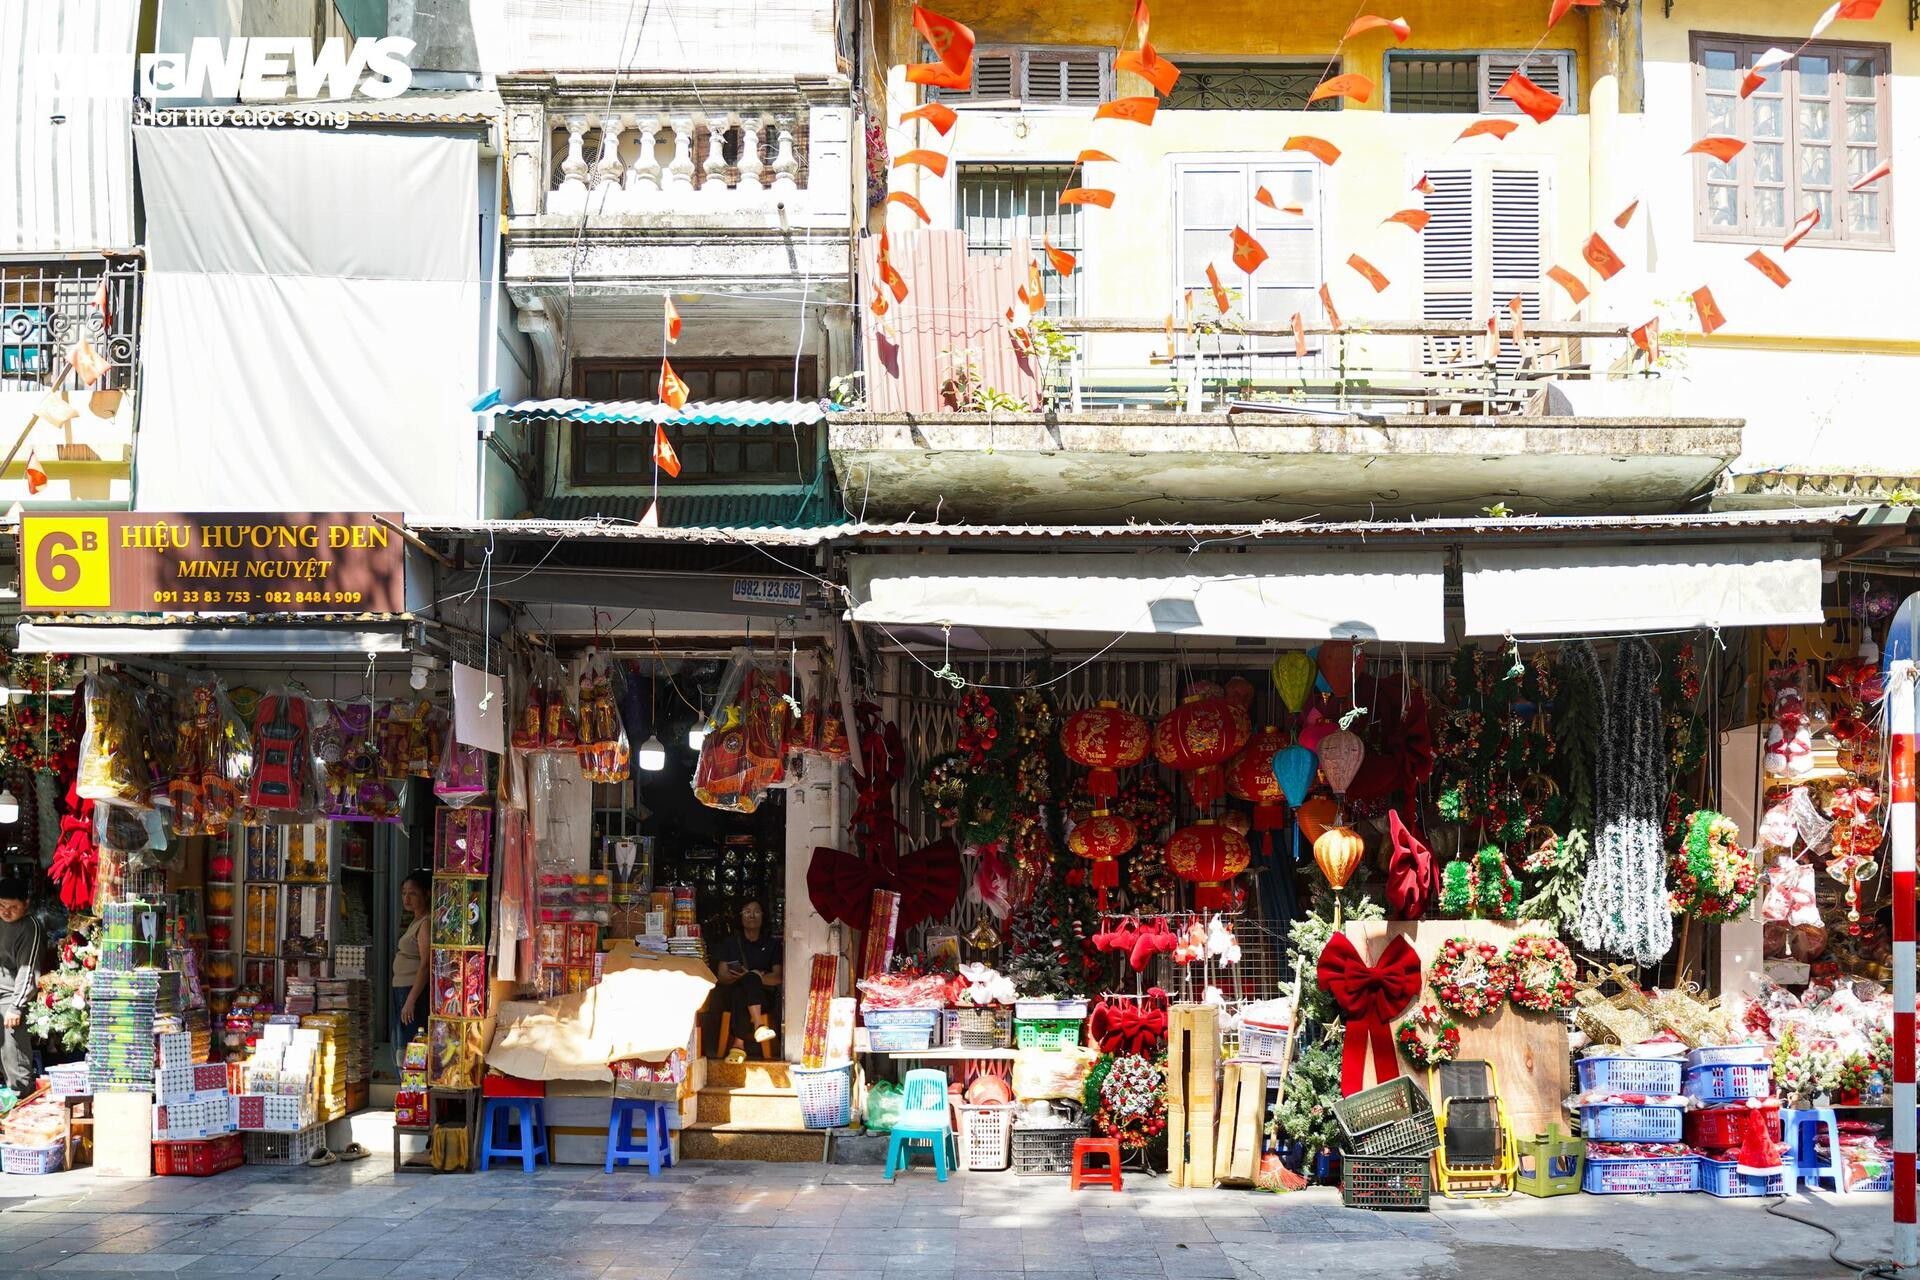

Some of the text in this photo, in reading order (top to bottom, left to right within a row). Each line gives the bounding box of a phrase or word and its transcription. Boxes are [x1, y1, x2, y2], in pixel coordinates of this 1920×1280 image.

[120, 521, 389, 553] HIỆU HƯƠNG ĐEN
[177, 557, 333, 582] MINH NGUYỆT
[153, 591, 178, 603] 091
[183, 591, 199, 603] 33
[203, 591, 221, 603] 83
[226, 591, 250, 603] 753
[265, 591, 291, 603] 082
[295, 591, 331, 603] 8484
[335, 591, 362, 604] 909
[735, 579, 801, 599] 0982.123.662
